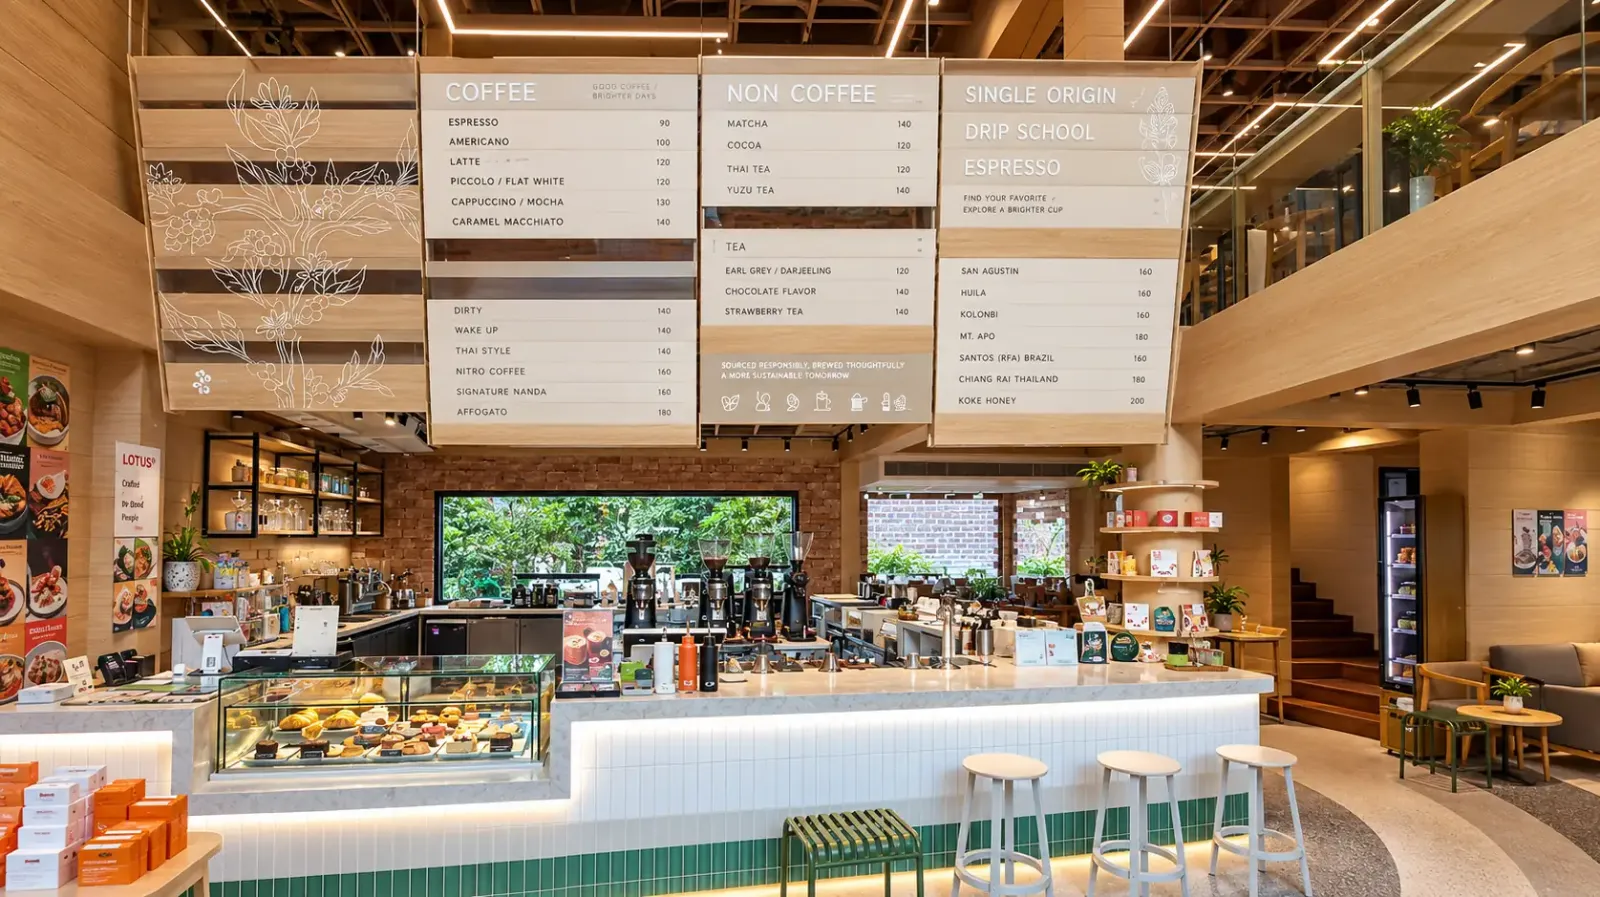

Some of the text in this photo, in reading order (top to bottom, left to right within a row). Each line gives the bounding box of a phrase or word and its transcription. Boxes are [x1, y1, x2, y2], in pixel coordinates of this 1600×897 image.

[446, 82, 536, 101] COFFEE
[728, 83, 778, 102] NON
[791, 84, 876, 102] COFFEE
[966, 86, 1116, 103] SINGLE ORIGIN
[448, 118, 499, 127] ESPRESSO
[727, 119, 768, 128] MATCHA
[966, 123, 1094, 140] DRIP SCHOOL
[449, 137, 671, 146] AMERICANO 100
[727, 141, 911, 150] COCOA 120
[450, 157, 480, 166] LATTE
[727, 165, 911, 174] THAI TEA 120
[965, 158, 1060, 175] ESPRESSO
[450, 177, 495, 186] PICCOLO
[505, 177, 529, 186] FLAT
[533, 177, 564, 185] WHITE
[727, 186, 752, 194] YUZU
[757, 186, 774, 194] TEA
[451, 198, 516, 206] CAPPUCCINO
[527, 198, 564, 206] MOCHA
[656, 198, 671, 206] 130
[452, 217, 500, 226] CARAMEL
[504, 217, 564, 226] MACCHIATO
[726, 242, 746, 251] TEA
[725, 267, 747, 275] EARL
[749, 267, 772, 275] GREY
[780, 267, 832, 275] DARJEELING
[982, 267, 1019, 275] AGUSTIN
[1139, 268, 1152, 276] 160
[725, 287, 778, 296] CHOCOLATE
[782, 287, 816, 296] FLAVOR
[454, 306, 482, 315] DIRTY
[725, 307, 783, 316] STRAWBERRY
[960, 310, 998, 318] KOLONBI
[486, 326, 498, 334] UP
[482, 346, 510, 355] STYLE
[959, 354, 994, 362] SANTOS
[998, 354, 1020, 362] (RFA)
[1024, 354, 1054, 362] BRAZIL
[759, 361, 810, 369] RESPONSIBLY,
[812, 361, 844, 369] BREWED
[456, 367, 485, 376] NITRO
[489, 367, 525, 376] COFFEE
[456, 388, 508, 396] SIGNATURE
[958, 397, 982, 405] KOKE
[986, 396, 1016, 405] HONEY
[457, 408, 508, 416] AFFOGATO
